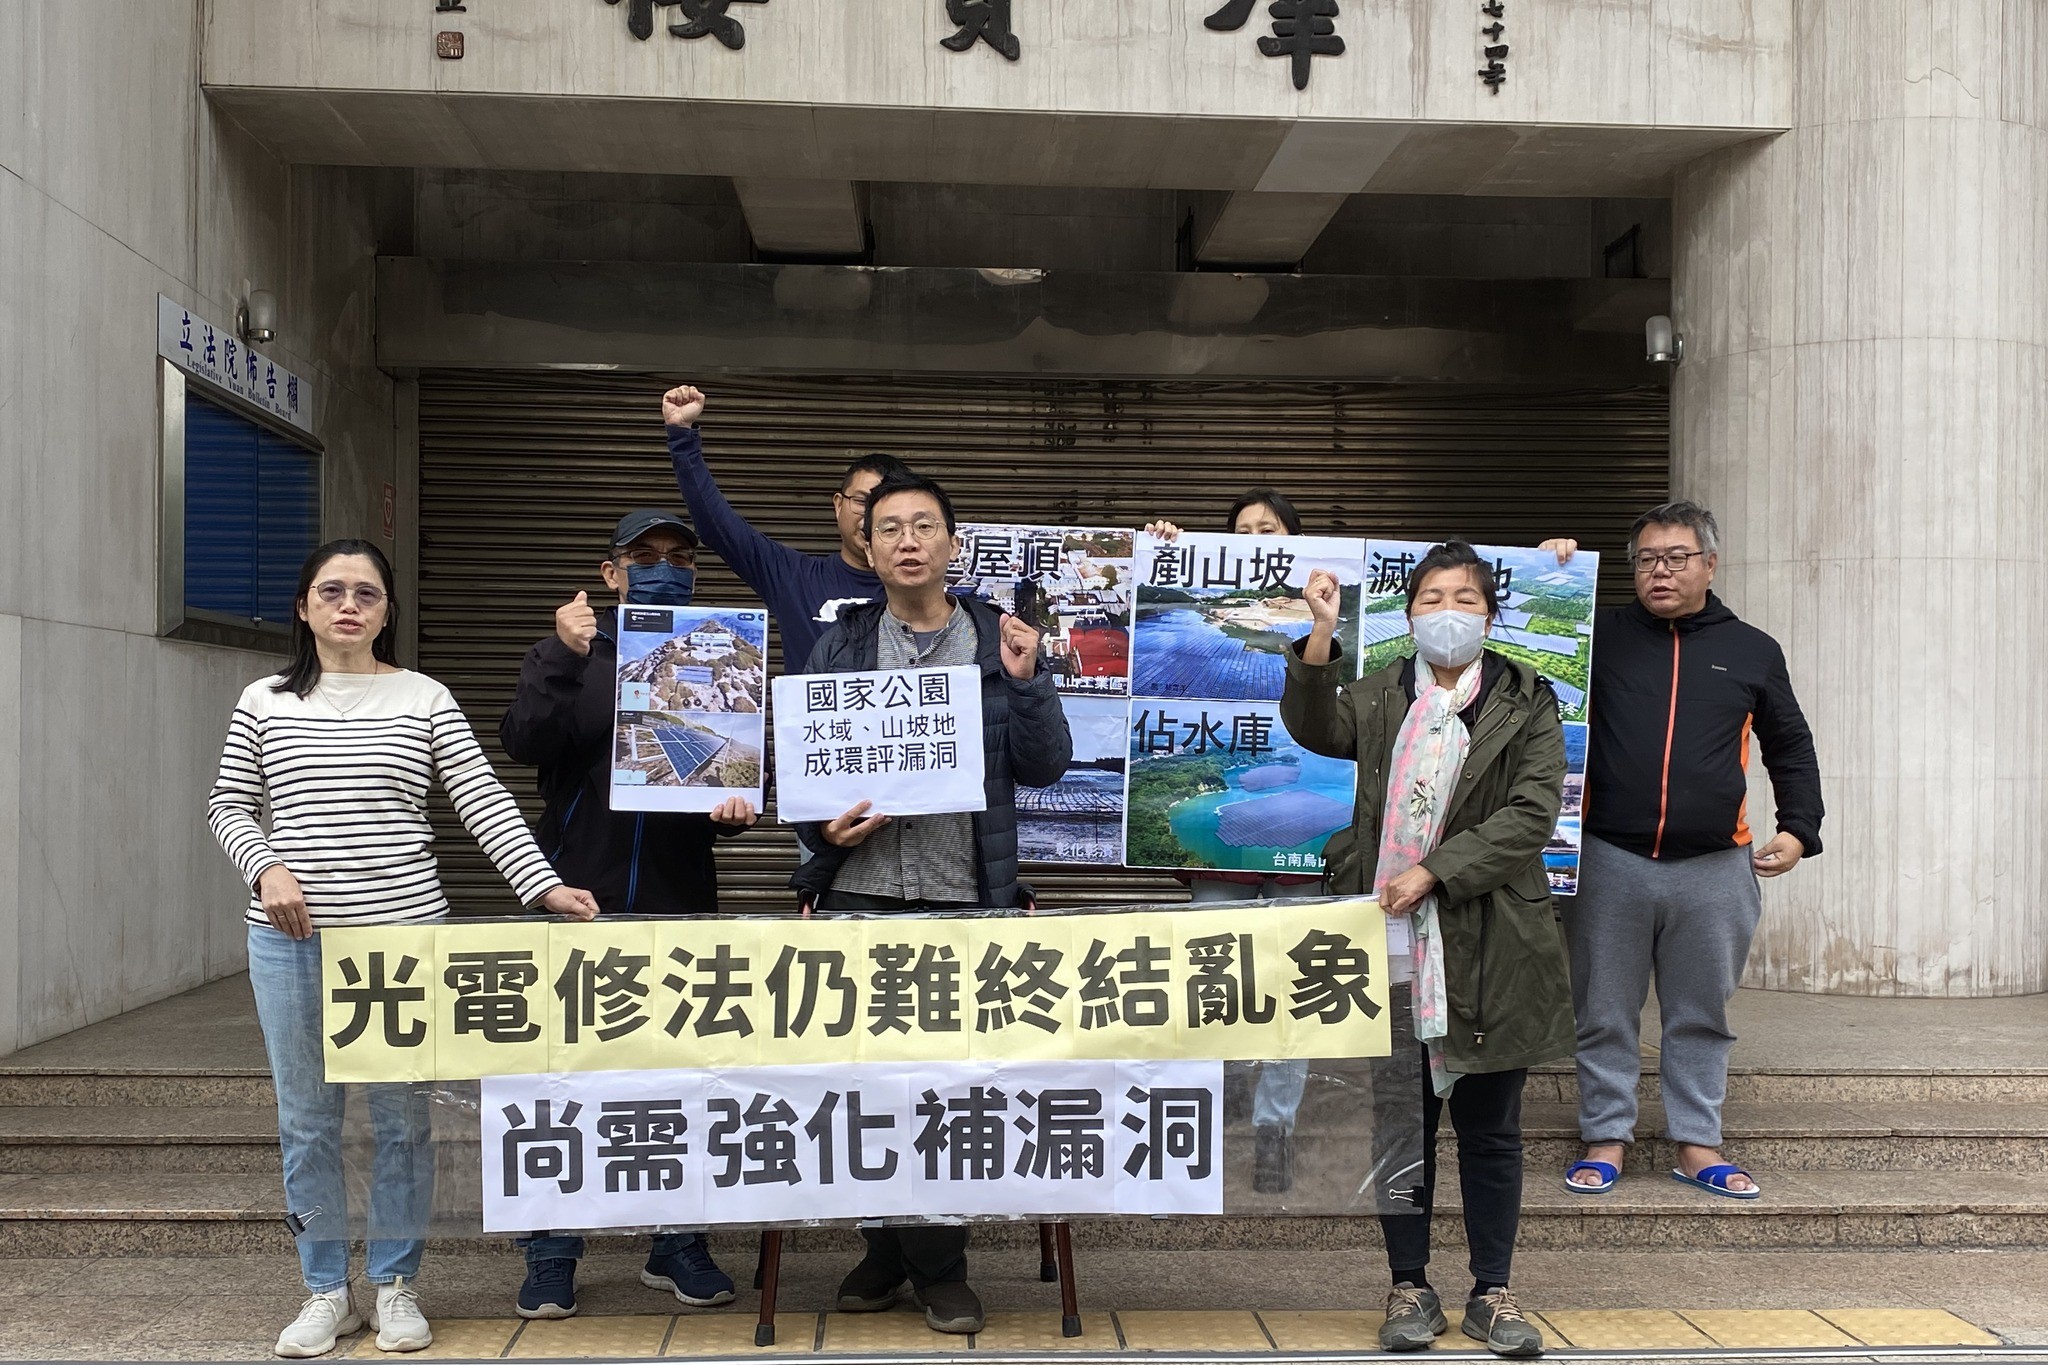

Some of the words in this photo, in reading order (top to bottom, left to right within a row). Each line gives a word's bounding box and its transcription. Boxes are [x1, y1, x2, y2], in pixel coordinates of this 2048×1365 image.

[180, 311, 298, 413] 立法院佈告欄
[187, 354, 222, 384] Legislative
[228, 377, 244, 395] Yuan
[247, 388, 270, 409] Bulletin
[275, 402, 292, 421] Board
[945, 534, 1063, 581] 屋頂
[1149, 543, 1298, 591] 剷山坡
[806, 672, 950, 714] 國家公園
[803, 712, 957, 744] 水域、山坡地
[1134, 709, 1274, 757] 佔水庫
[804, 740, 958, 777] 成環評漏洞
[330, 928, 1383, 1050] 光電修法仍難終結亂象
[502, 1085, 1213, 1197] 尚需強化補漏洞
